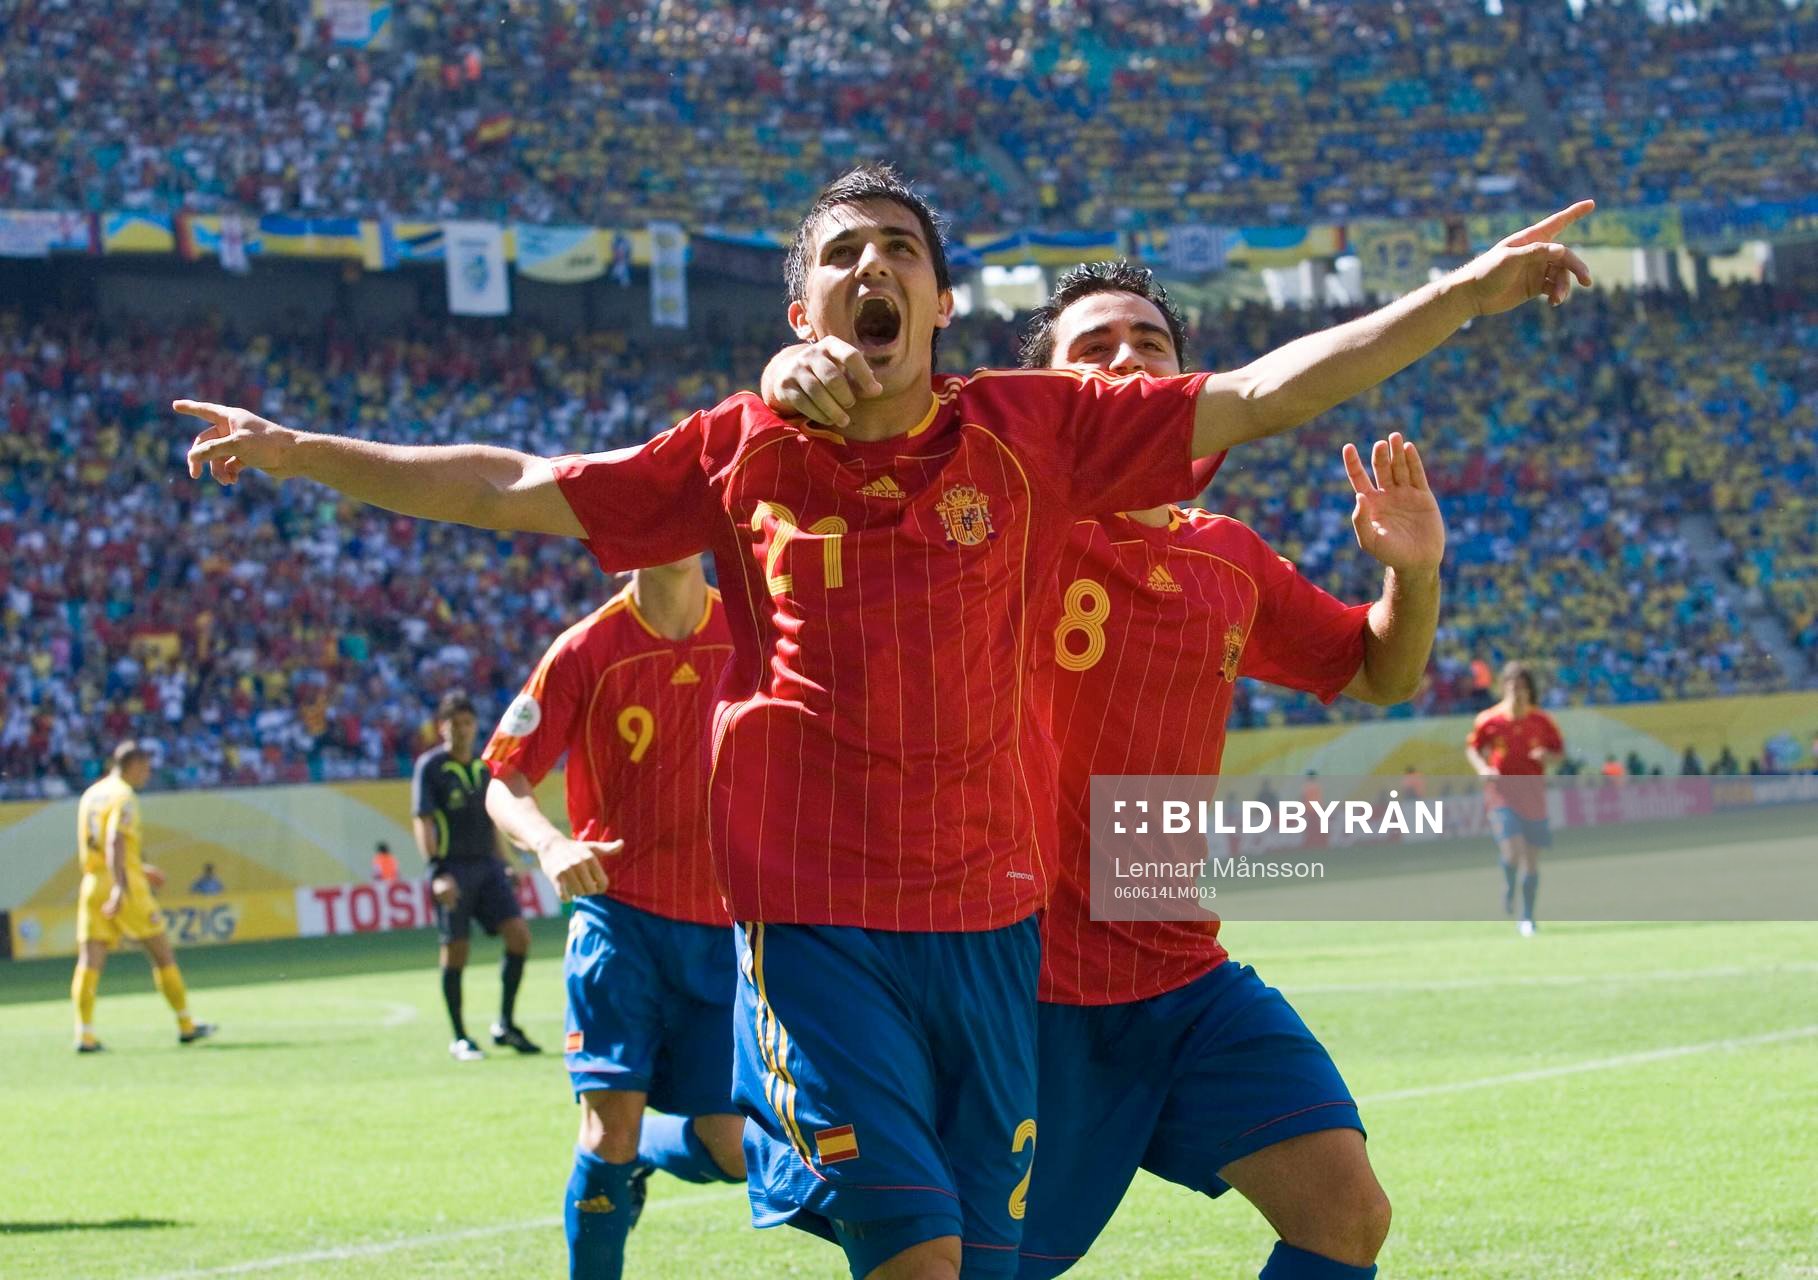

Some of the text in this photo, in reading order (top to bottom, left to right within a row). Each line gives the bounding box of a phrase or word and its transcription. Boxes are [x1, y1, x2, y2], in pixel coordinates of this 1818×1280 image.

[751, 500, 848, 597] 21
[1054, 578, 1111, 672] 8
[617, 705, 654, 764] 9
[312, 872, 545, 934] TOSA
[1008, 1118, 1037, 1220] 2
